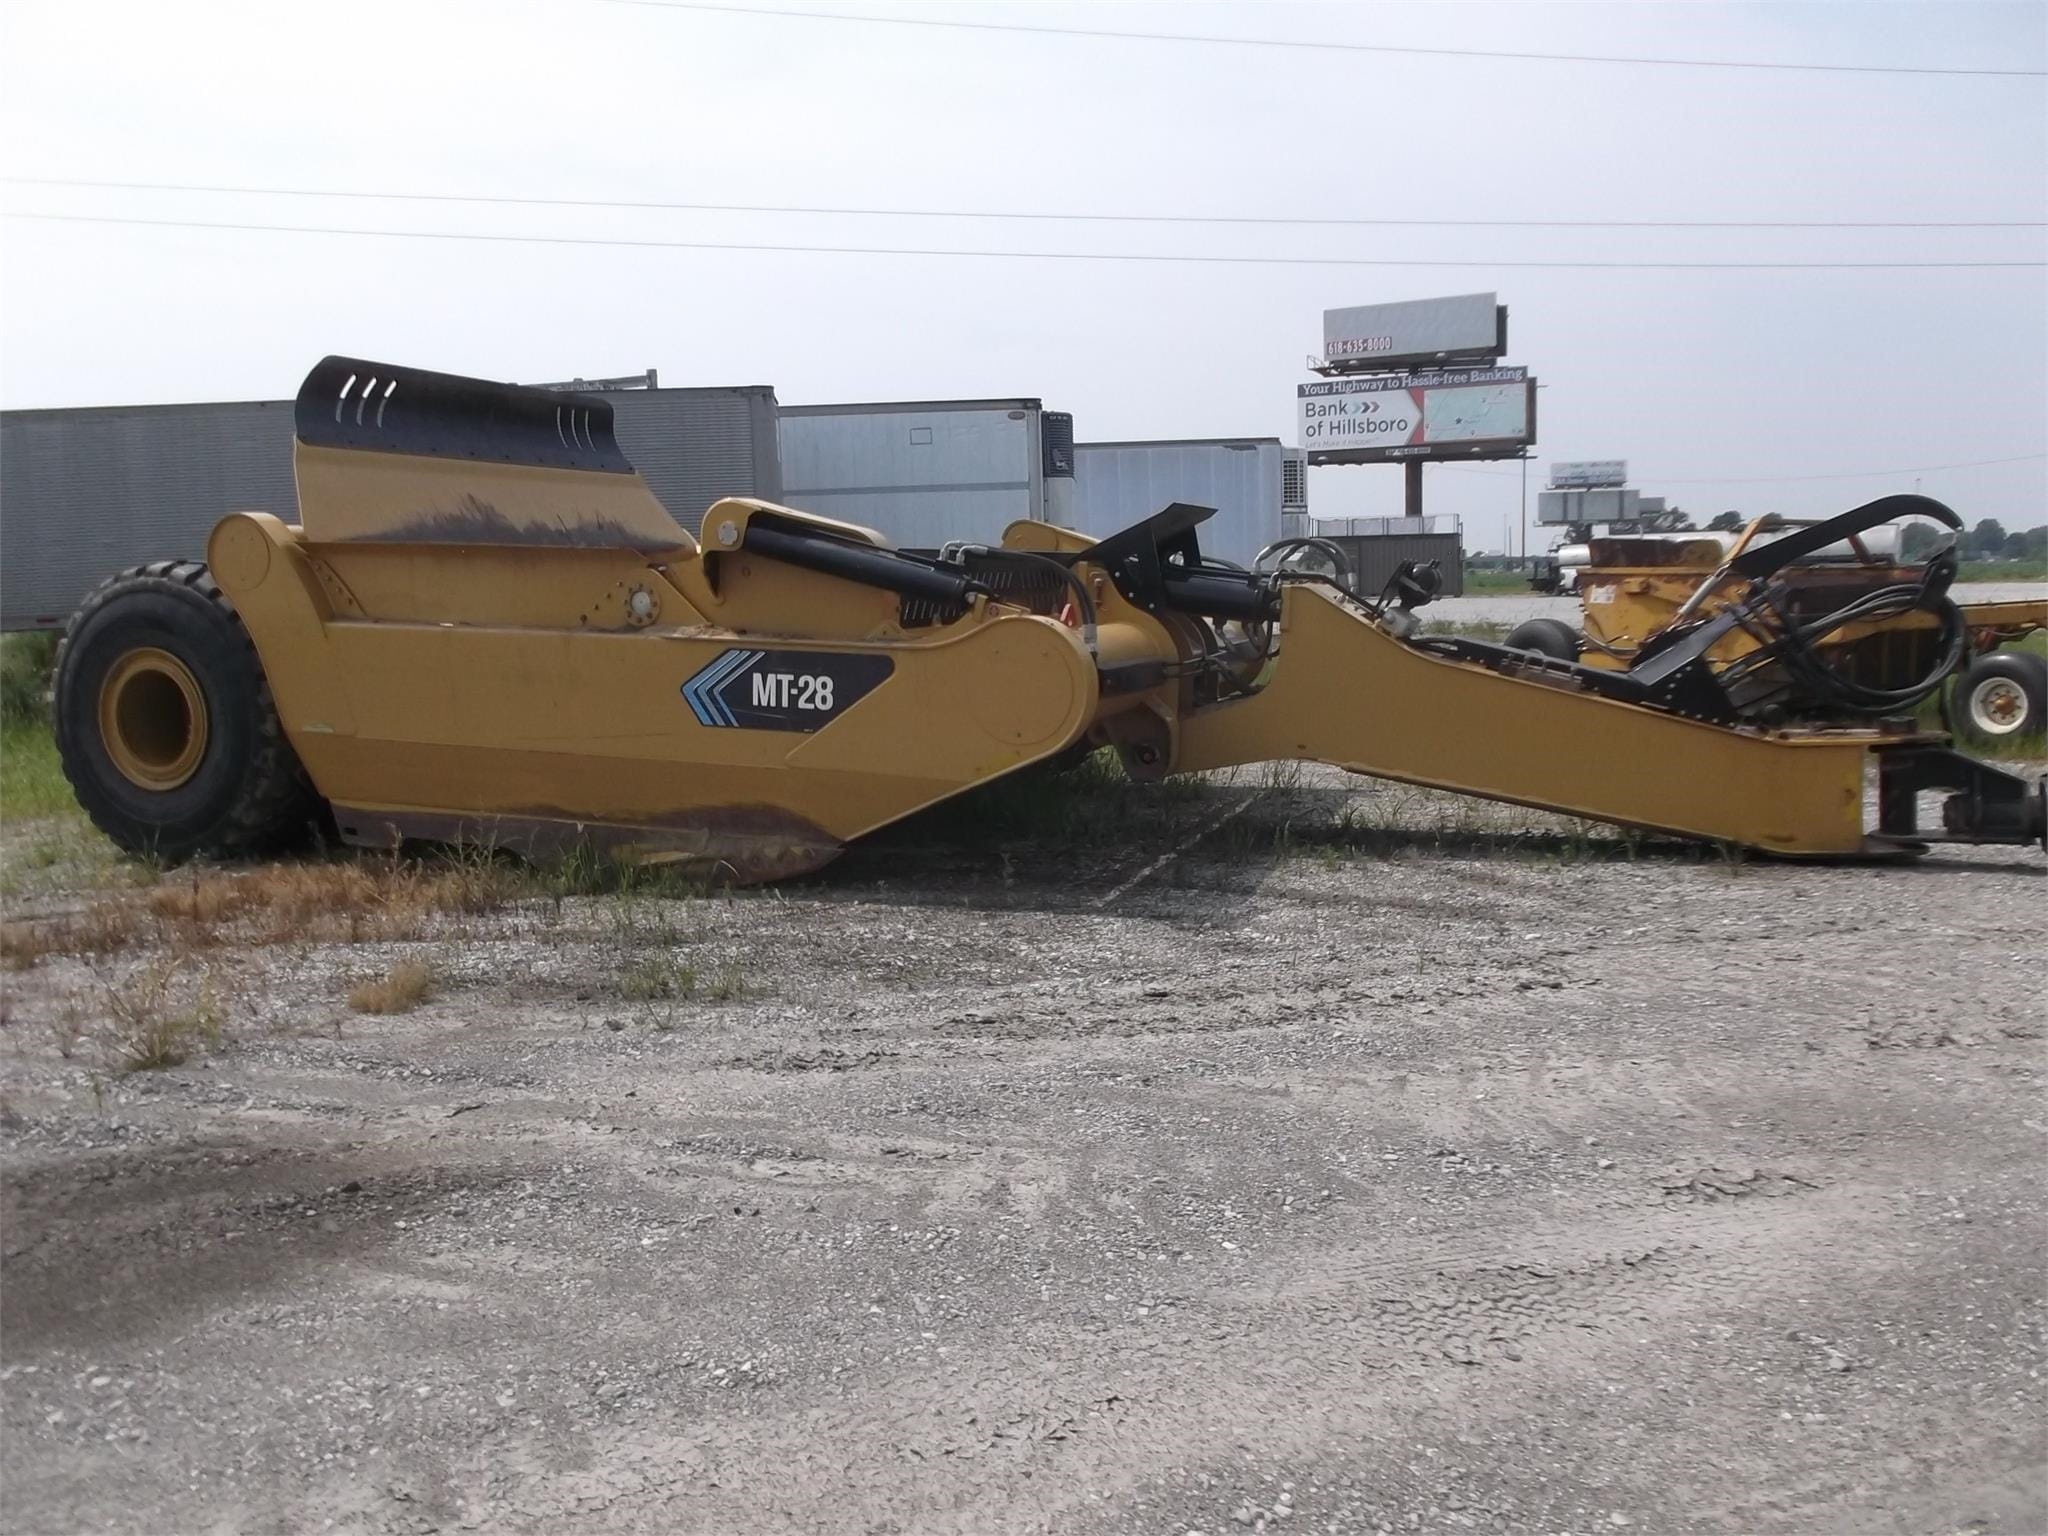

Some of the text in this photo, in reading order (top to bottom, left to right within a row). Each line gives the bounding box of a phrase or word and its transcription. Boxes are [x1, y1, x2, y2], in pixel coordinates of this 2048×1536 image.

[1327, 336, 1392, 355] 618-635-8000
[1303, 367, 1523, 396] Your Highway to Hassle-free Banking
[1305, 399, 1348, 418] Bank
[1305, 417, 1408, 437] of Hillsboro
[752, 672, 834, 711] MT-28
